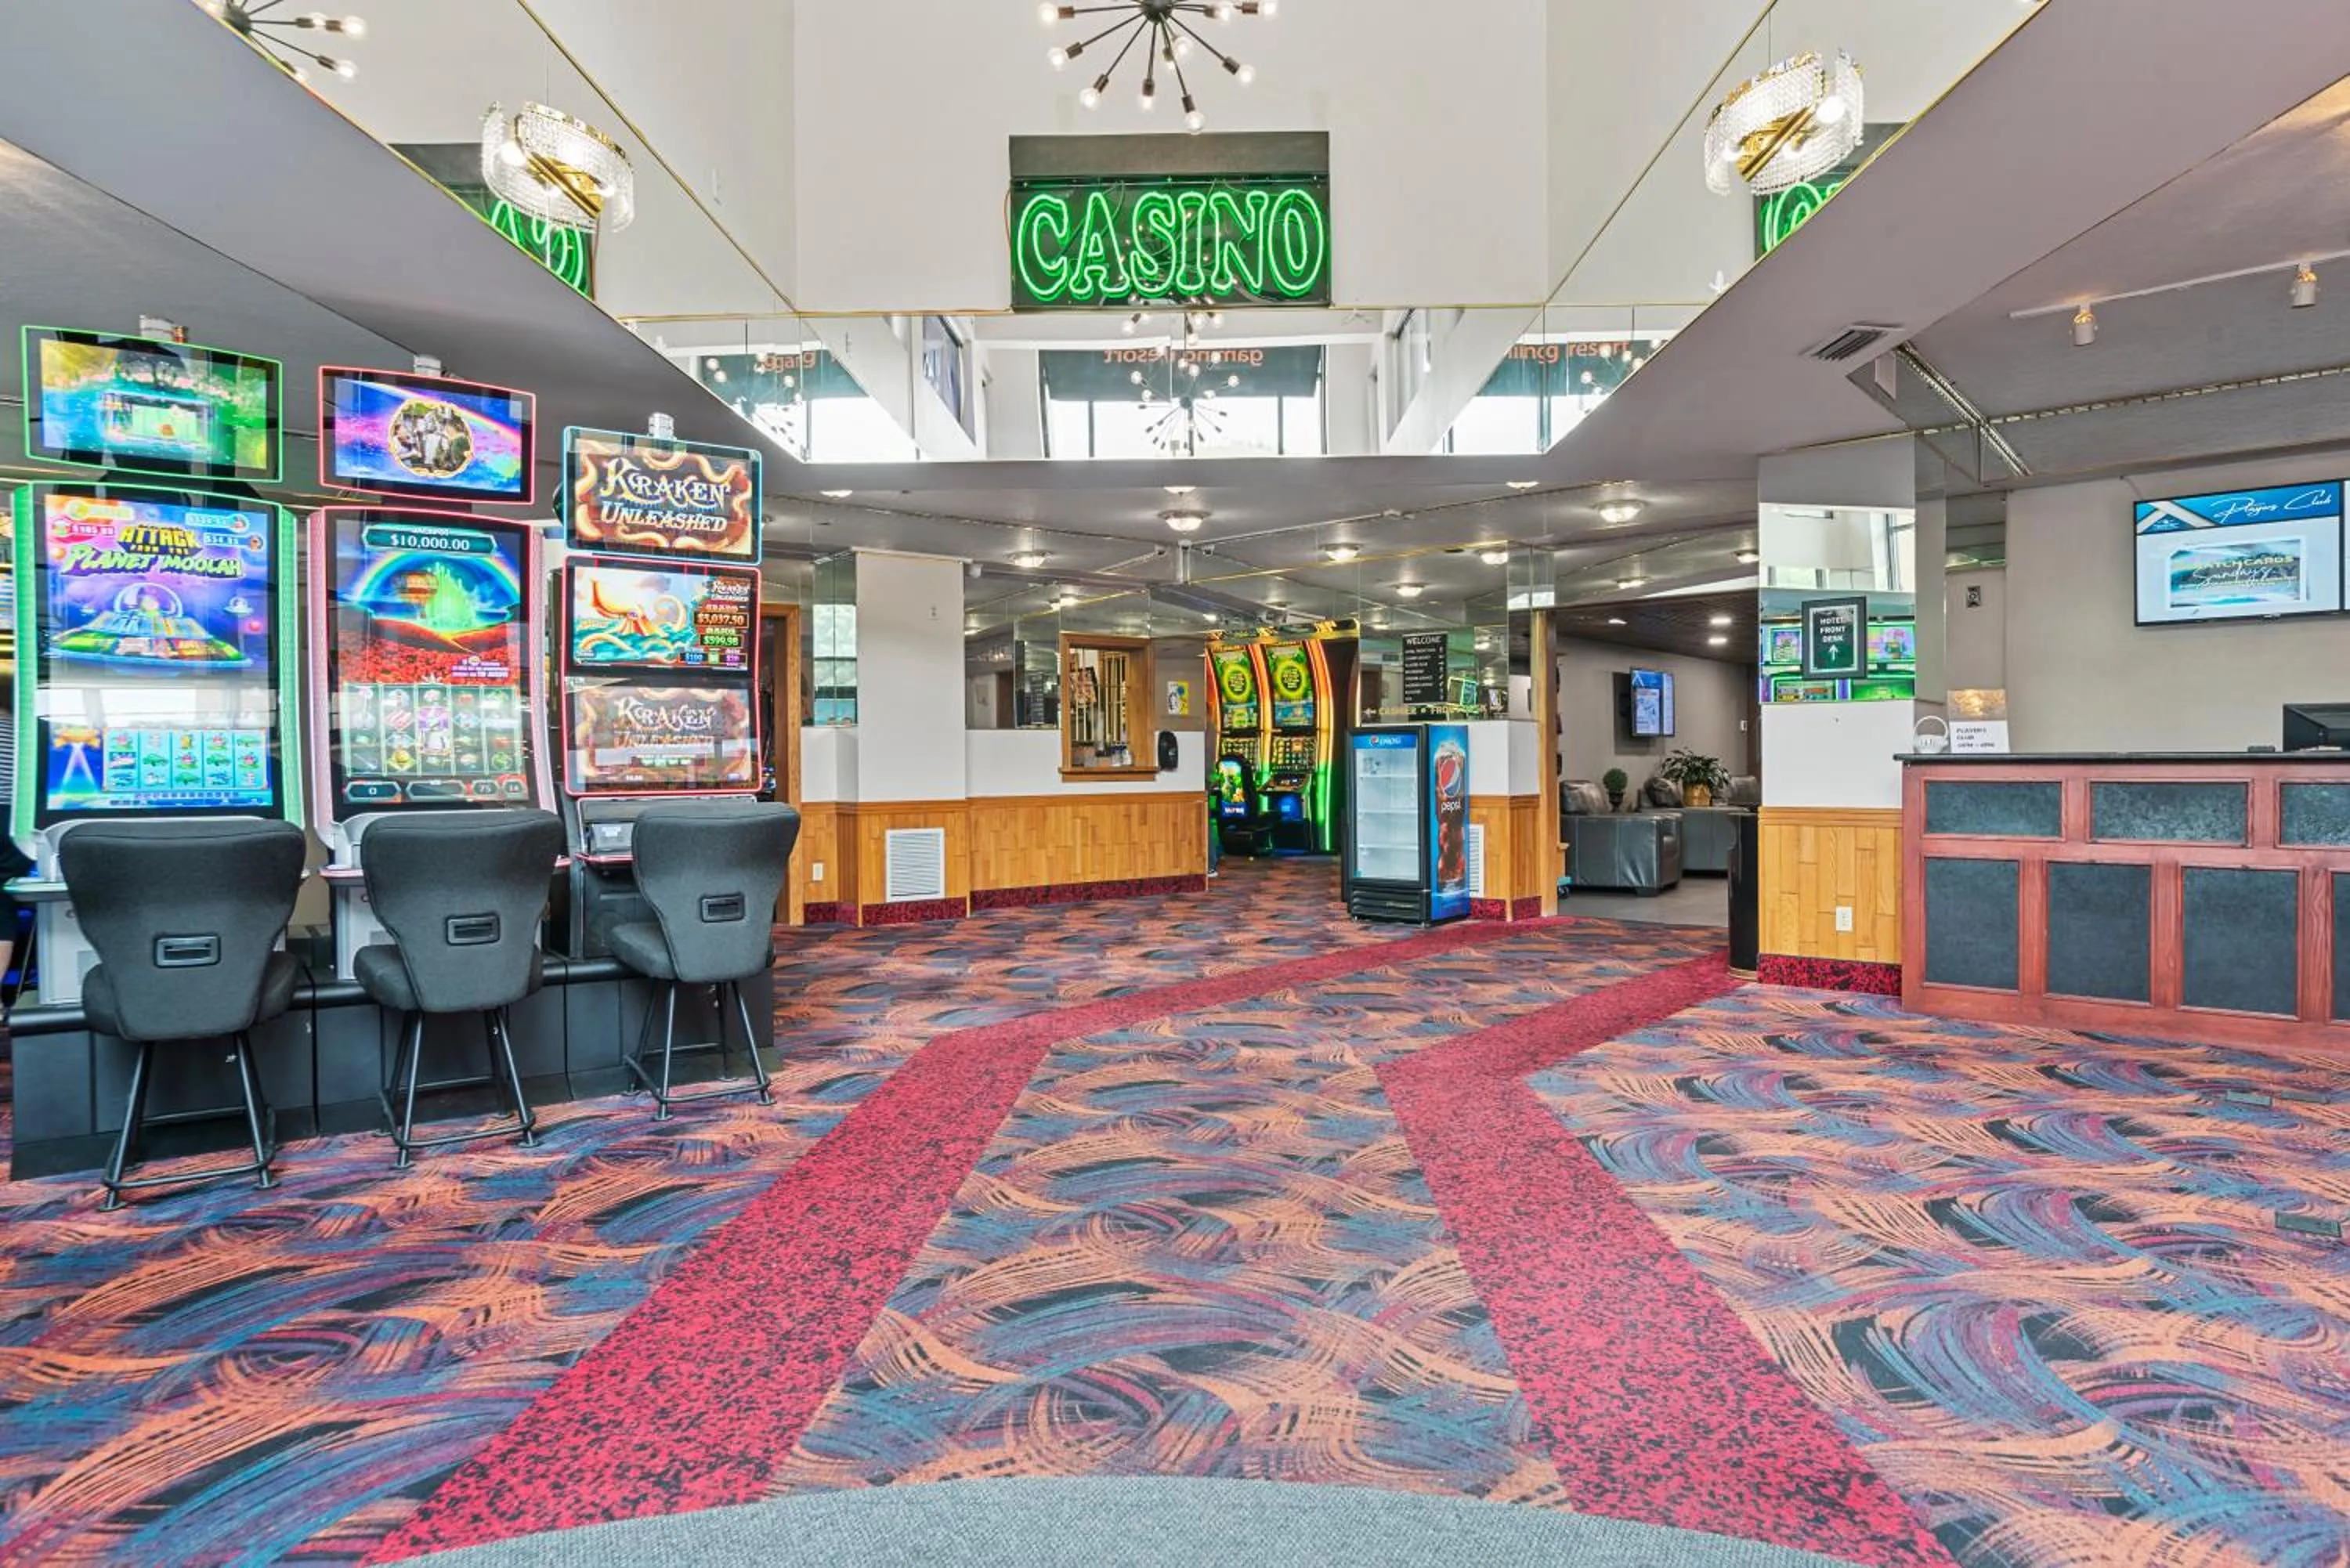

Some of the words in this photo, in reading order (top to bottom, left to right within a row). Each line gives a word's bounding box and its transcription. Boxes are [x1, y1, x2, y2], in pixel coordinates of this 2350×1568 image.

[1018, 190, 1324, 300] CASINO
[600, 456, 732, 511] KRAKEN
[601, 500, 728, 533] UNLEASHED
[119, 524, 202, 548] ATTACK
[390, 533, 470, 551] $10,000.00
[62, 545, 152, 574] PLANET
[161, 552, 244, 578] MOOLAH
[613, 695, 717, 732] KRAKEN
[1441, 800, 1462, 814] pepsi
